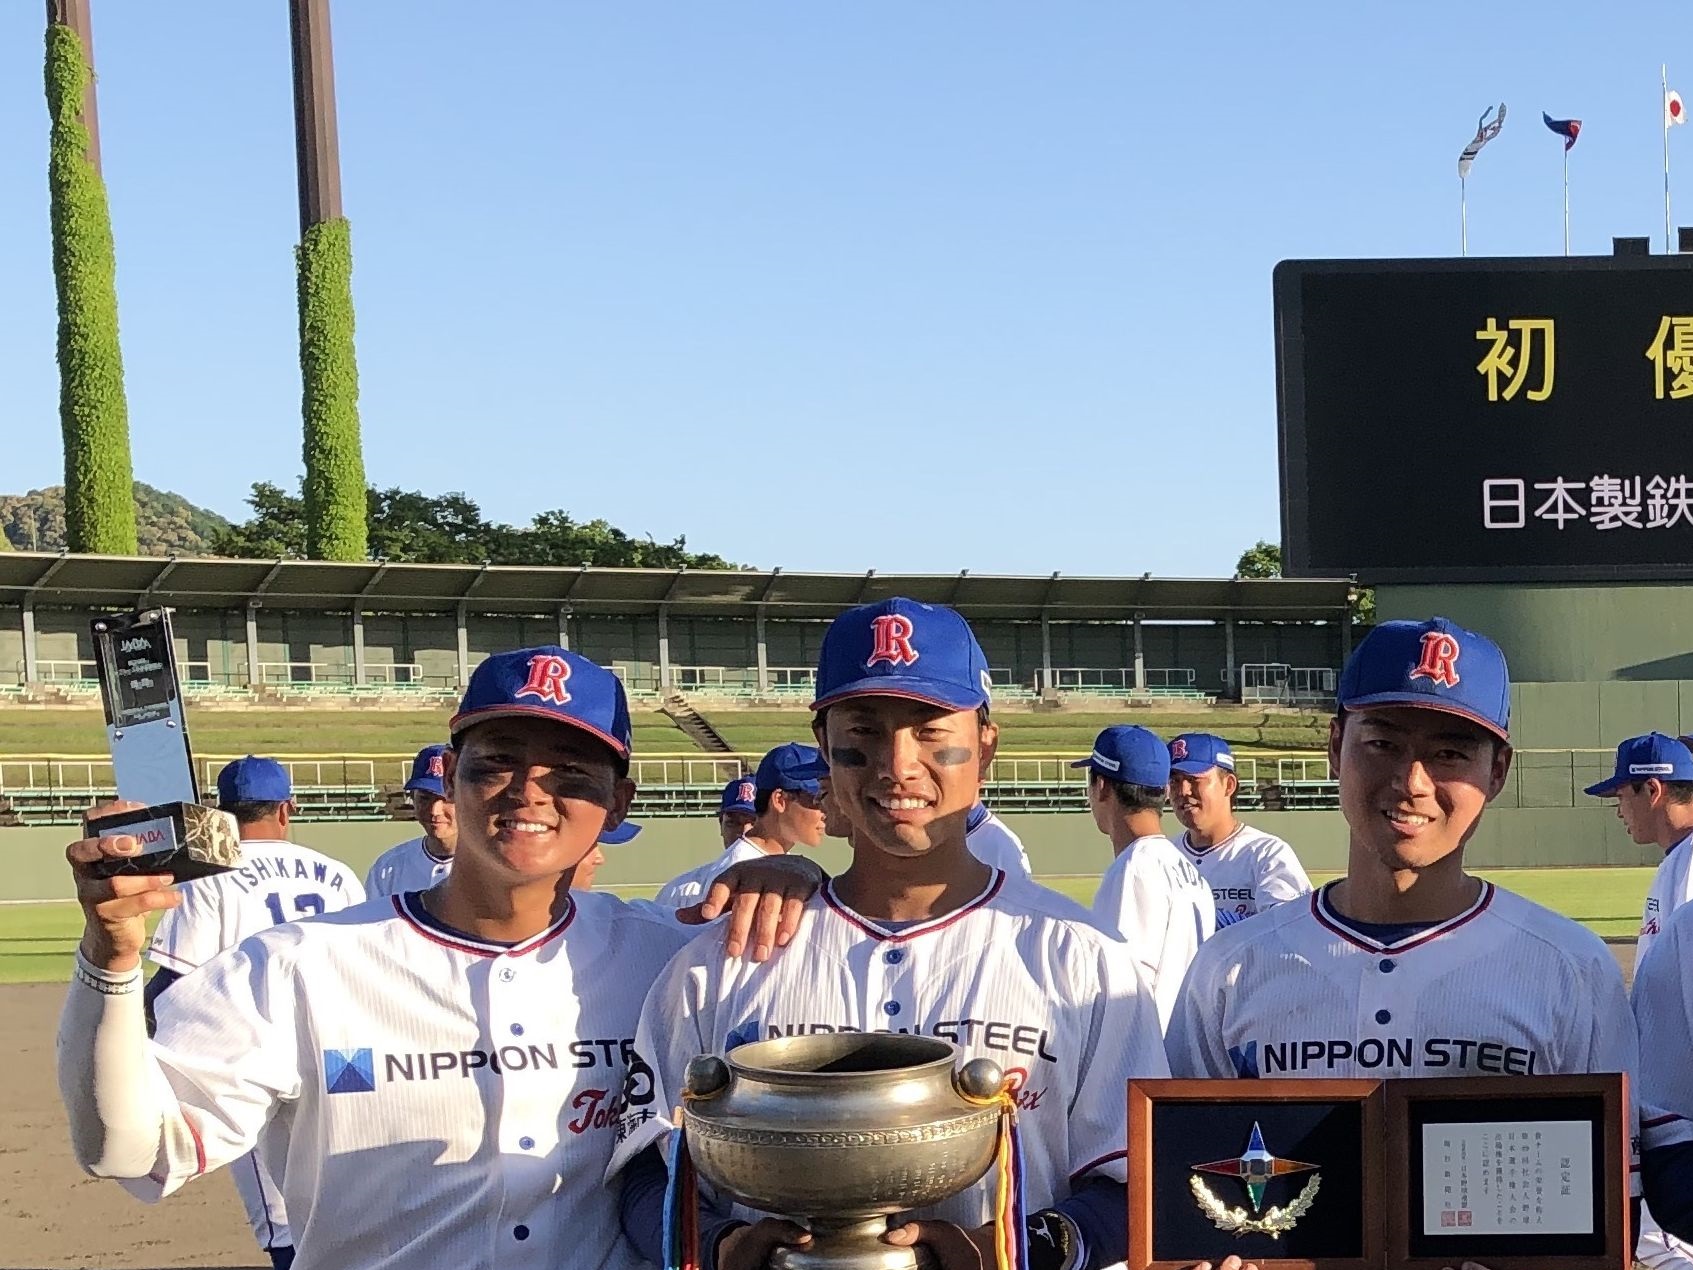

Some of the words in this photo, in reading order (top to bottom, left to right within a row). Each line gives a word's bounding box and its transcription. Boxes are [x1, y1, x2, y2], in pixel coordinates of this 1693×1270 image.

[867, 614, 919, 667] R
[1410, 631, 1460, 688] R
[515, 655, 572, 705] R
[230, 856, 344, 894] ISHIKAWA
[385, 1043, 559, 1082] NIPPON
[568, 1038, 636, 1068] STE
[1264, 1038, 1413, 1073] NIPPON
